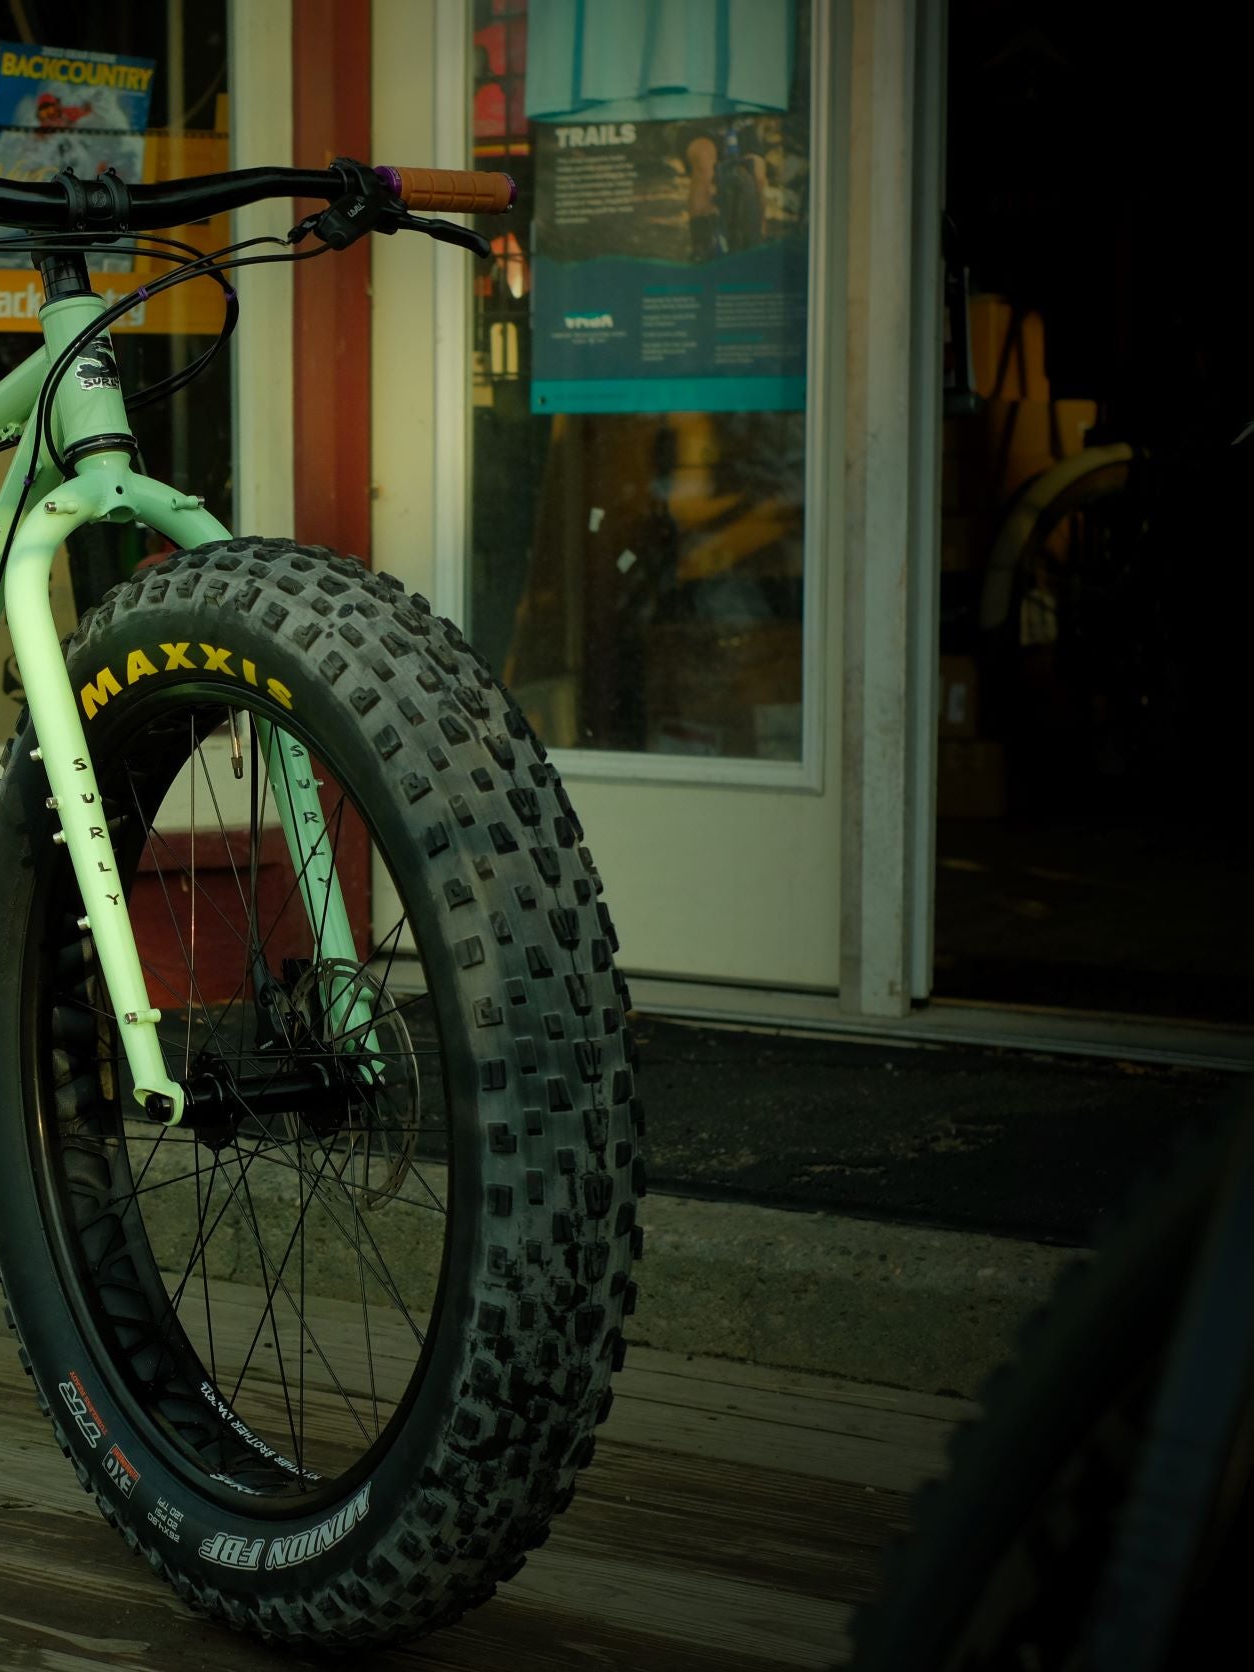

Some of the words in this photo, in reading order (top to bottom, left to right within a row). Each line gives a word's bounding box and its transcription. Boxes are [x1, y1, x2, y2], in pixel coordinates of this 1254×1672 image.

[0, 52, 154, 91] BACKCOUNTRY
[554, 123, 636, 148] TRAILS
[79, 641, 294, 721] MAXXIS
[72, 757, 120, 906] SURLY
[58, 1381, 102, 1449] TR
[104, 1456, 132, 1493] EXO
[154, 1507, 168, 1522] PSI
[157, 1496, 170, 1511] TPI
[169, 1506, 184, 1522] 120
[264, 1481, 373, 1571] MINION
[197, 1531, 266, 1571] FBF
